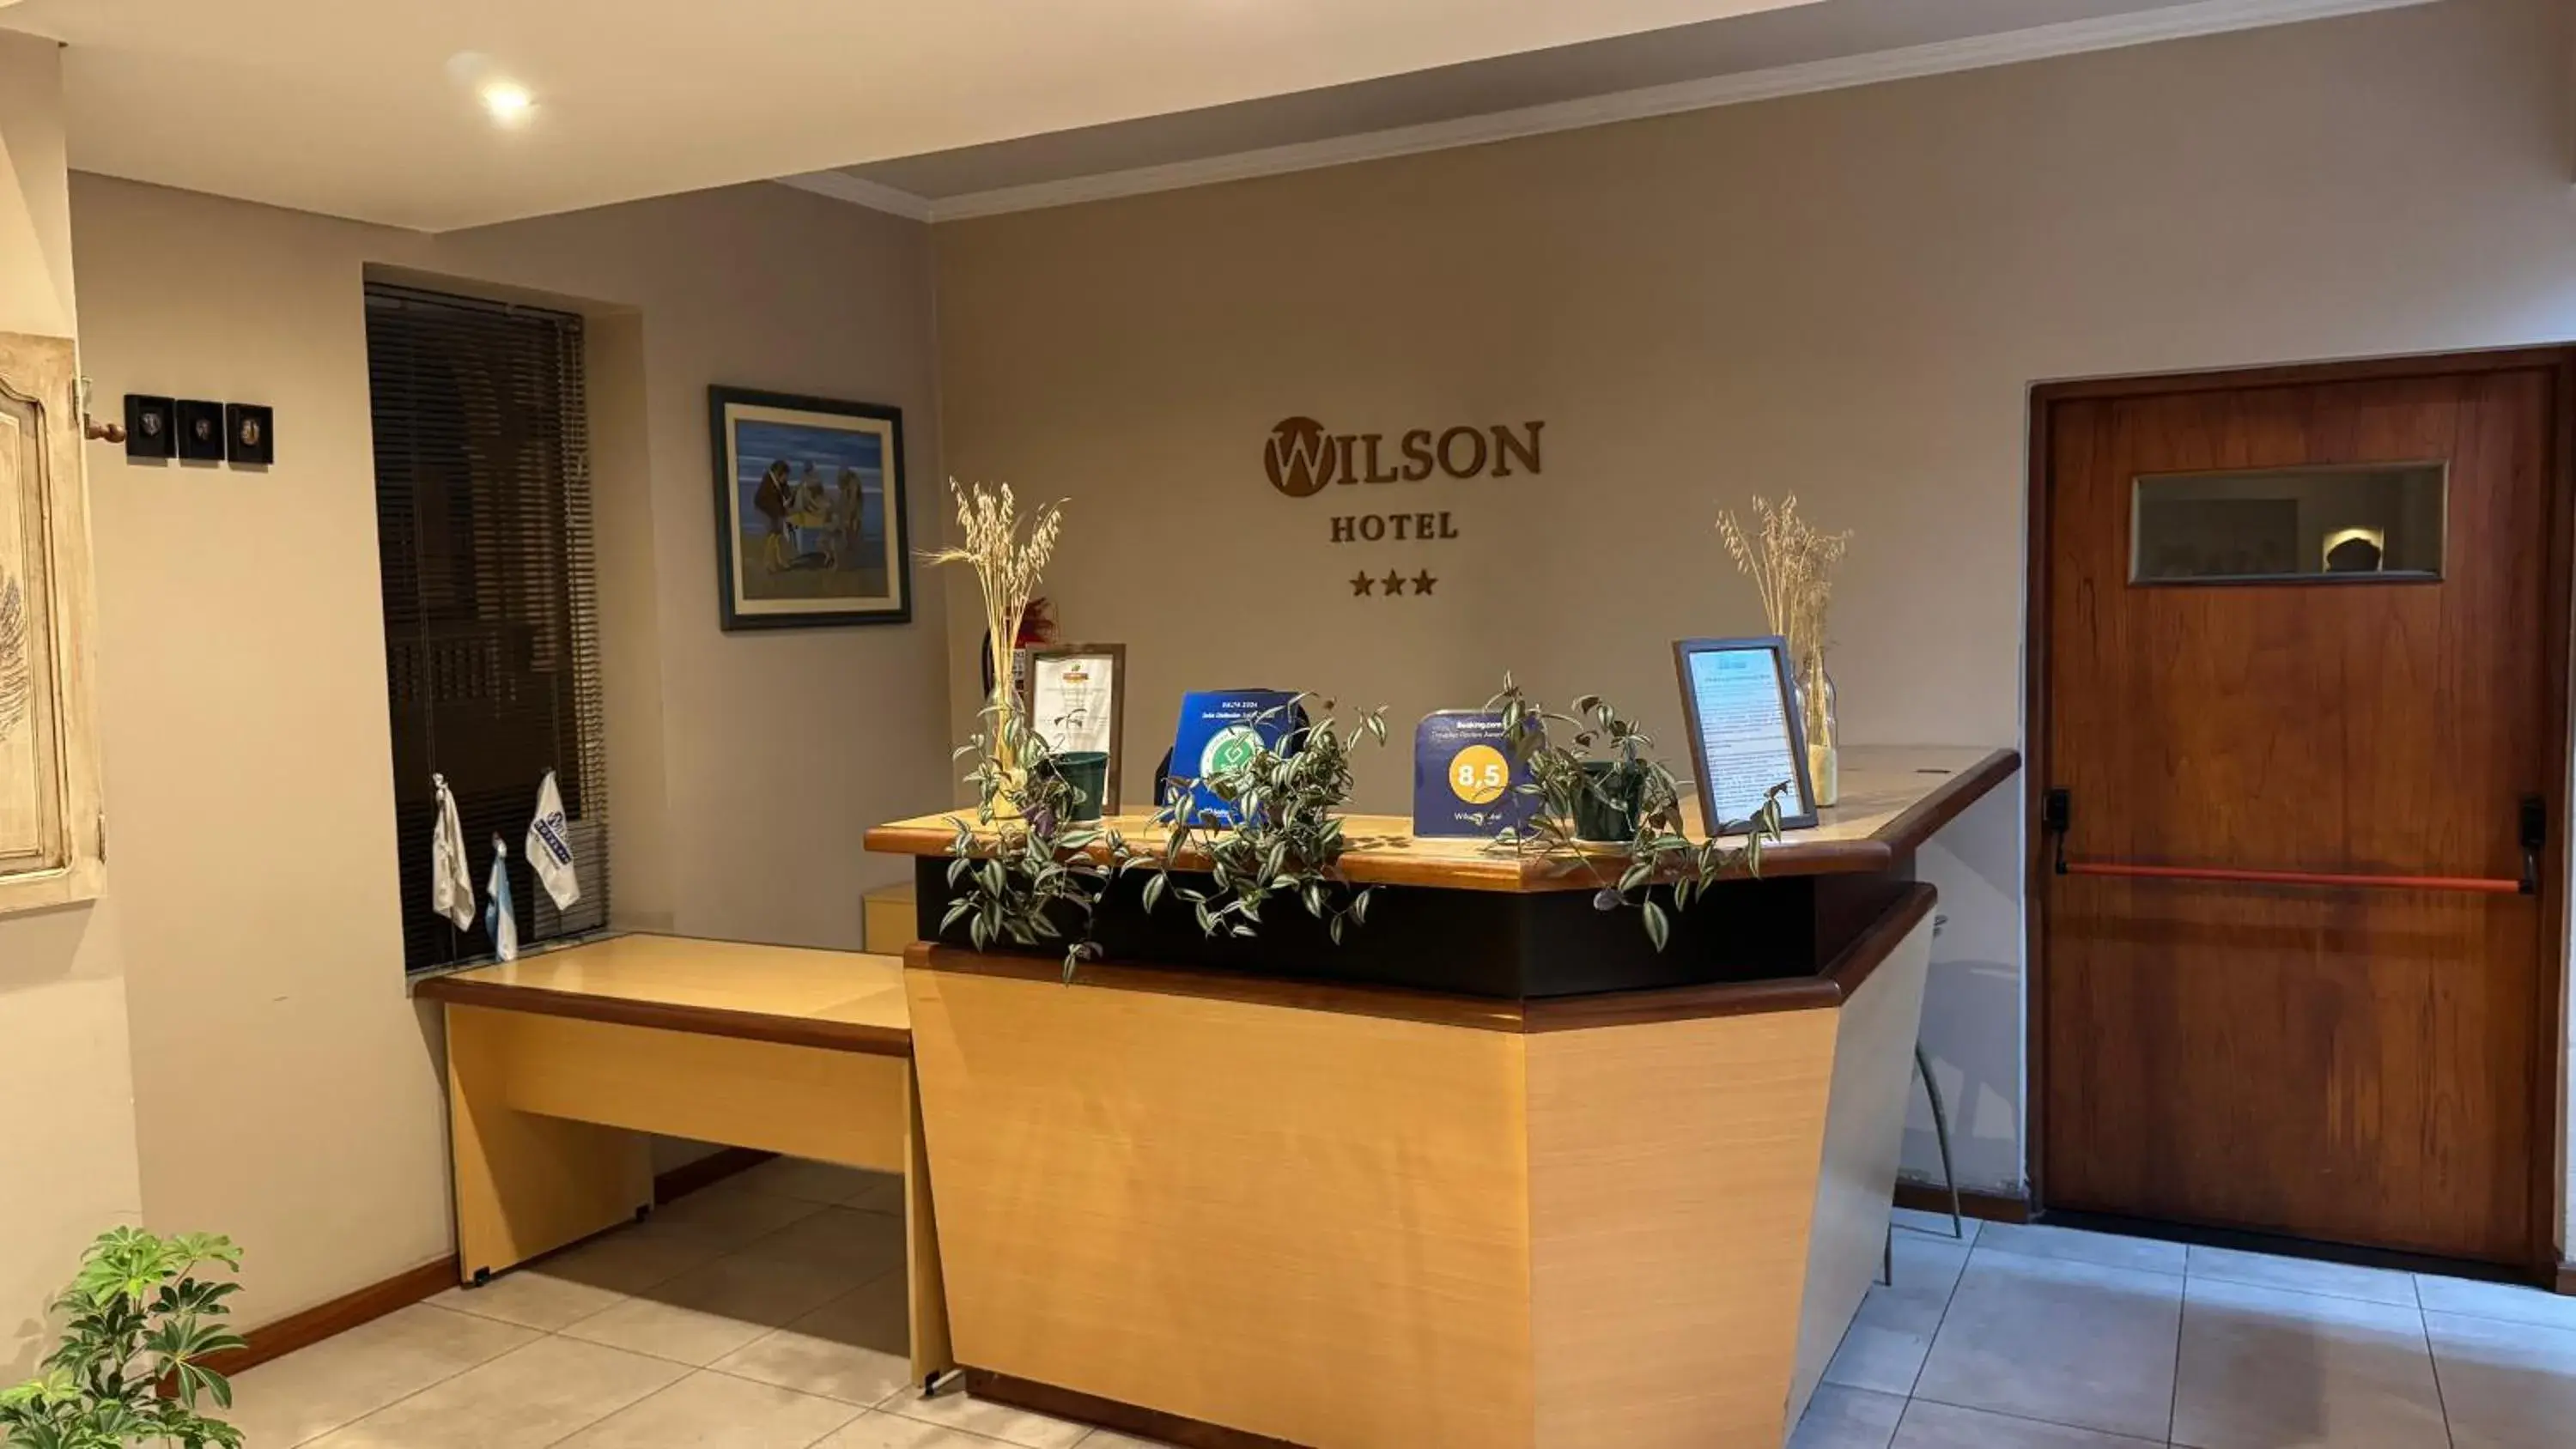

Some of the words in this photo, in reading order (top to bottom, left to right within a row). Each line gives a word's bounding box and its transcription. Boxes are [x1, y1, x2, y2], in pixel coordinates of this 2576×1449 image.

[1264, 416, 1545, 498] WILSON
[1330, 512, 1458, 543] HOTEL
[1458, 764, 1500, 789] 8,5
